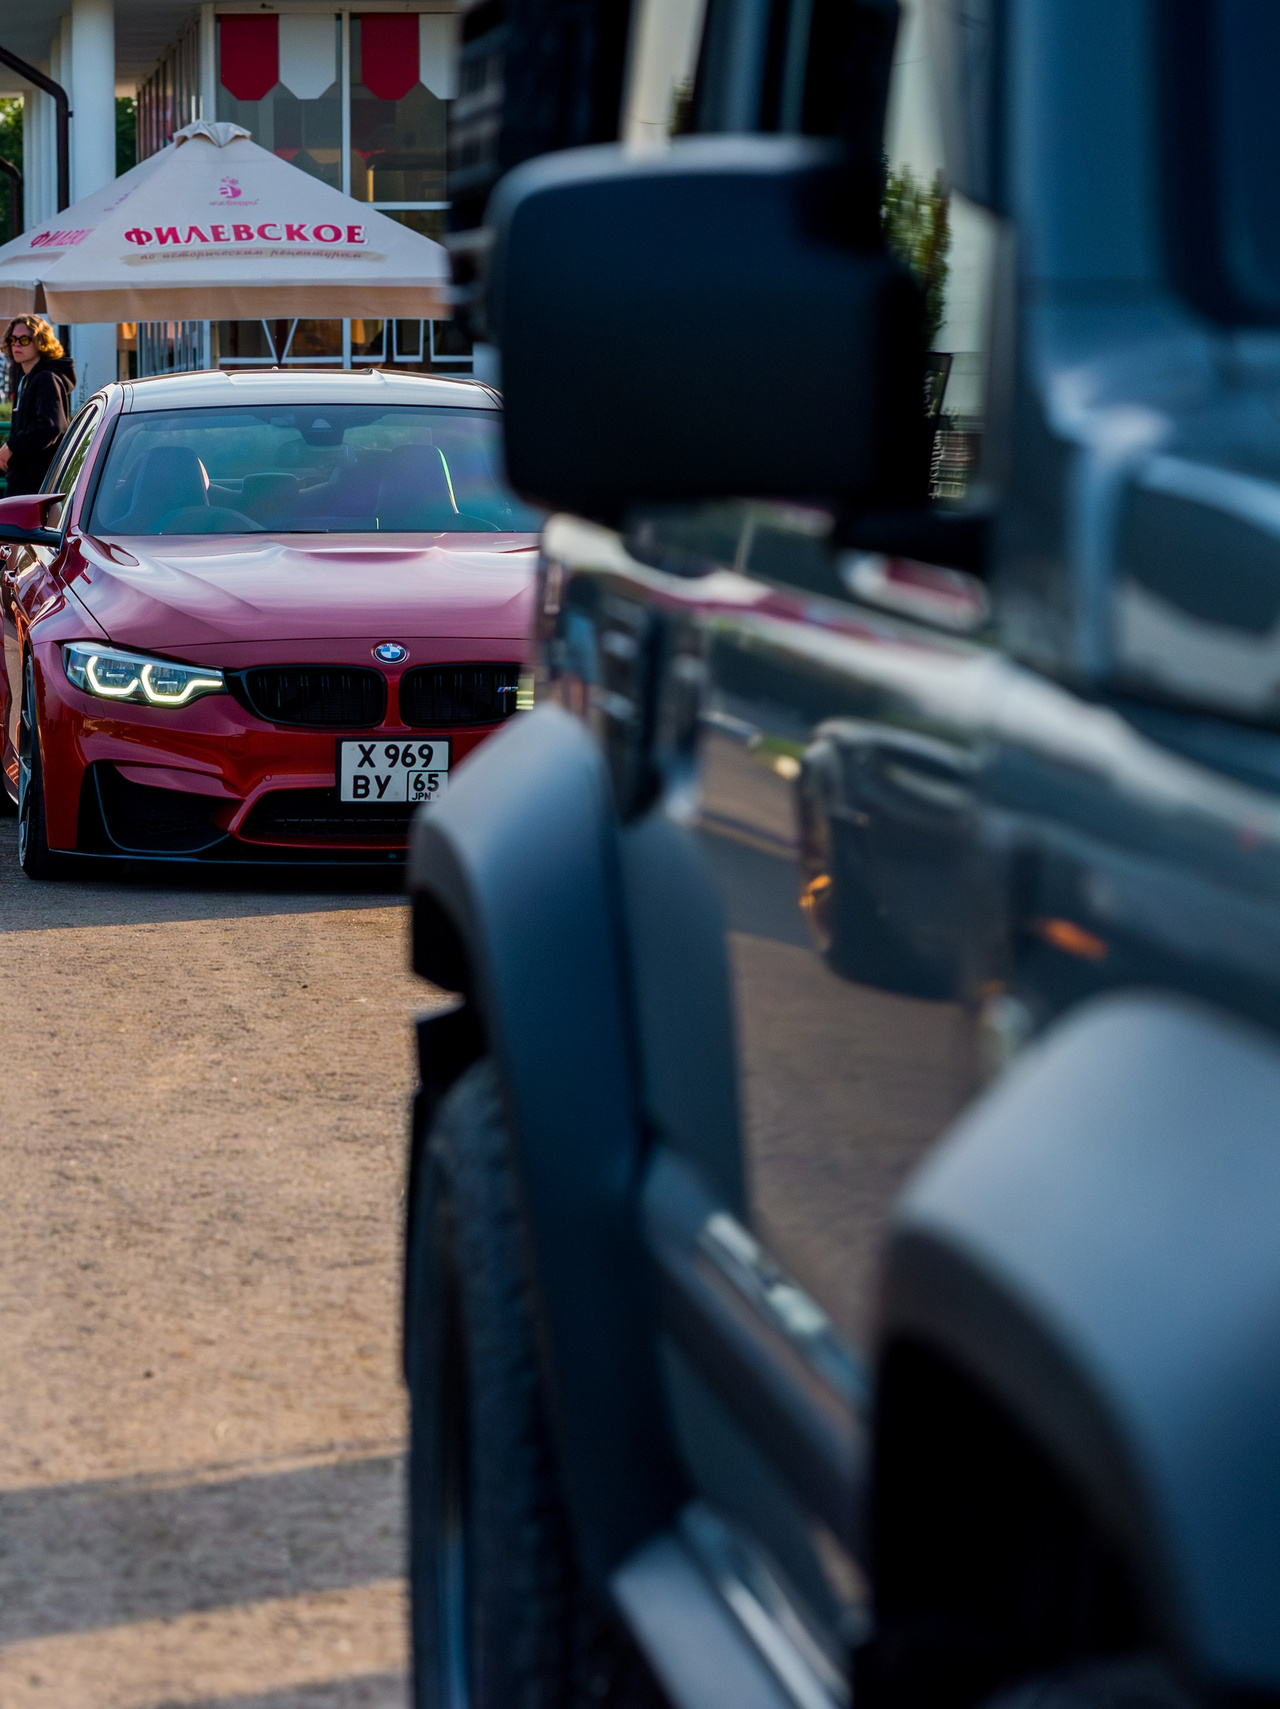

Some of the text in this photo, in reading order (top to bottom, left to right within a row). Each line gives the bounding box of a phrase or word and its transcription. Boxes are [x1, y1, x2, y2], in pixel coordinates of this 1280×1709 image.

[124, 223, 366, 246] ФИЛЕВСКОЕ
[384, 743, 434, 768] 969
[413, 773, 439, 792] 65
